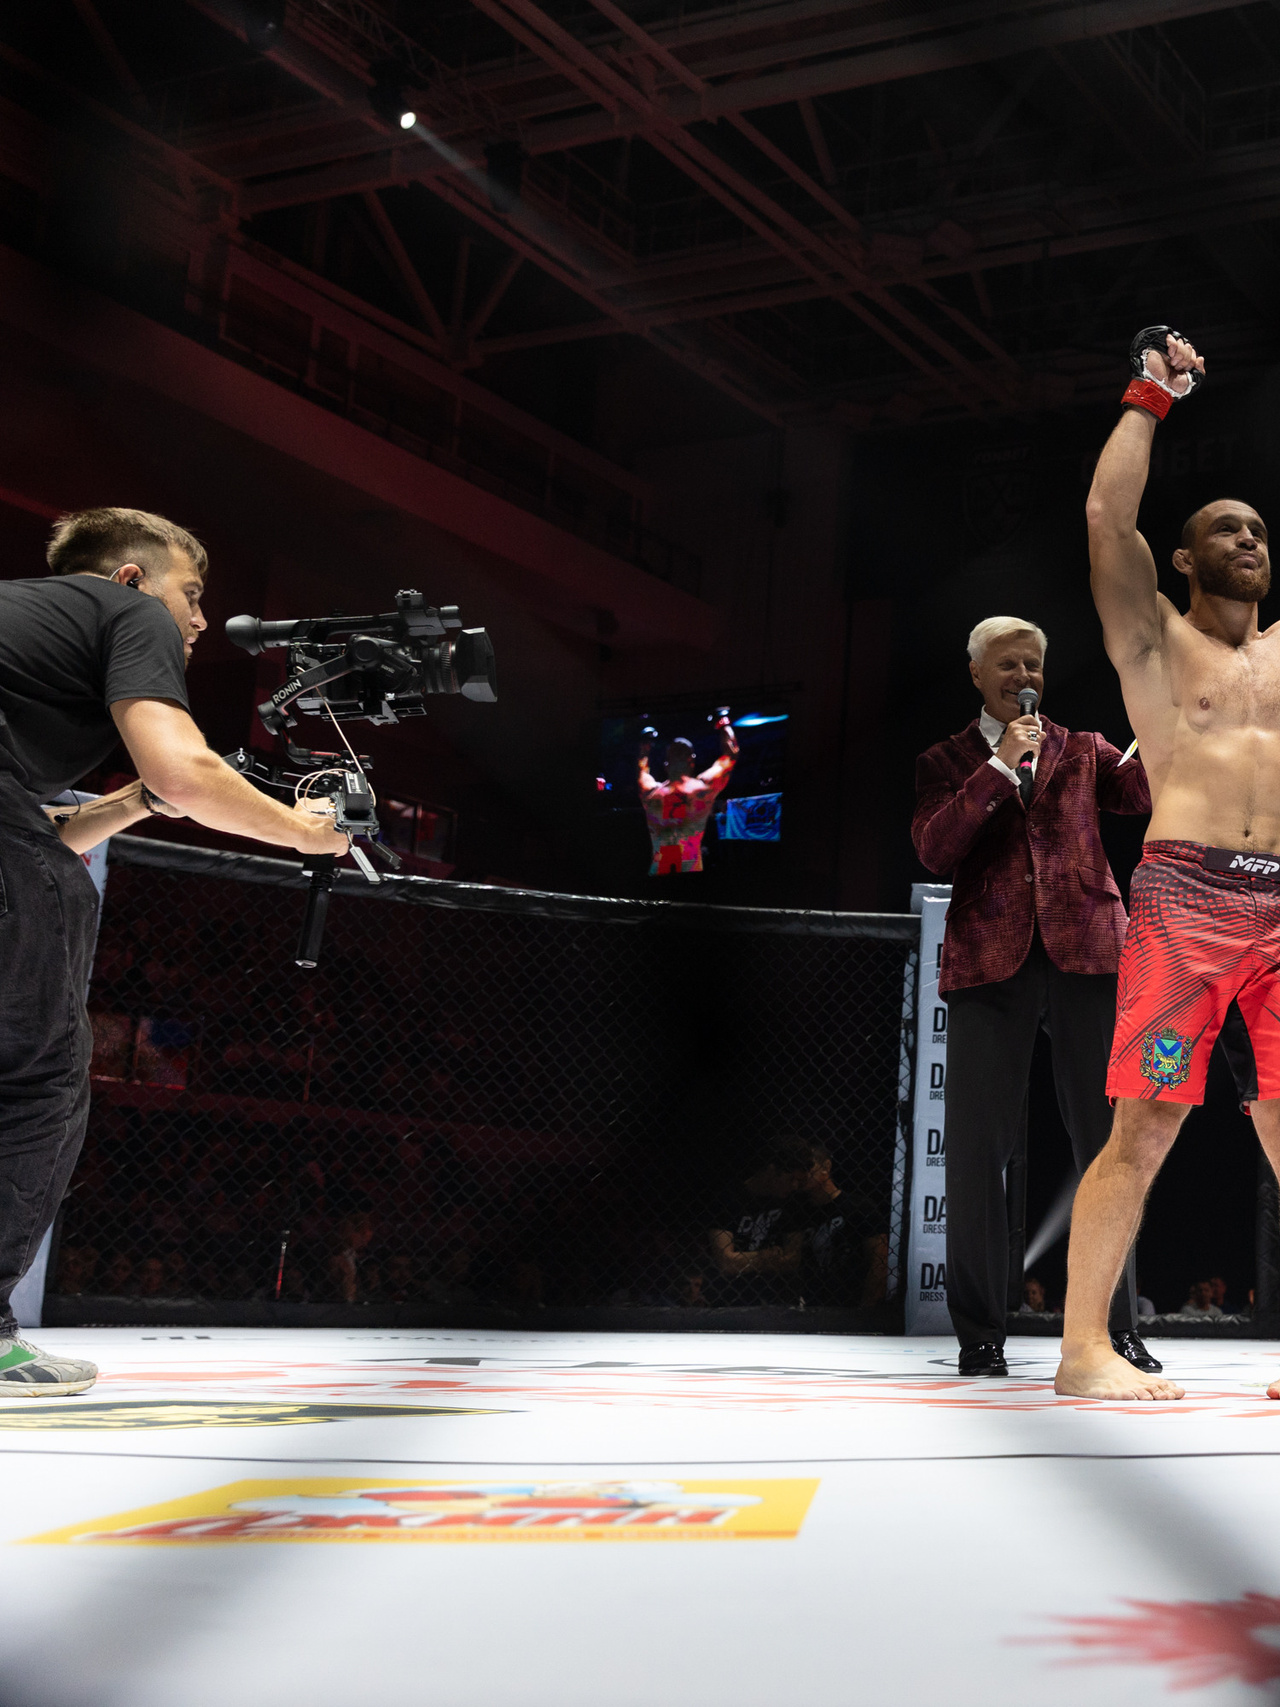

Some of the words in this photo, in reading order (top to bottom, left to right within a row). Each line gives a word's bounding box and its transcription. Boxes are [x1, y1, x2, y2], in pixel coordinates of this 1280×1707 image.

[272, 678, 304, 705] RONIN
[1229, 853, 1280, 875] MFP
[920, 1291, 945, 1302] DRESS
